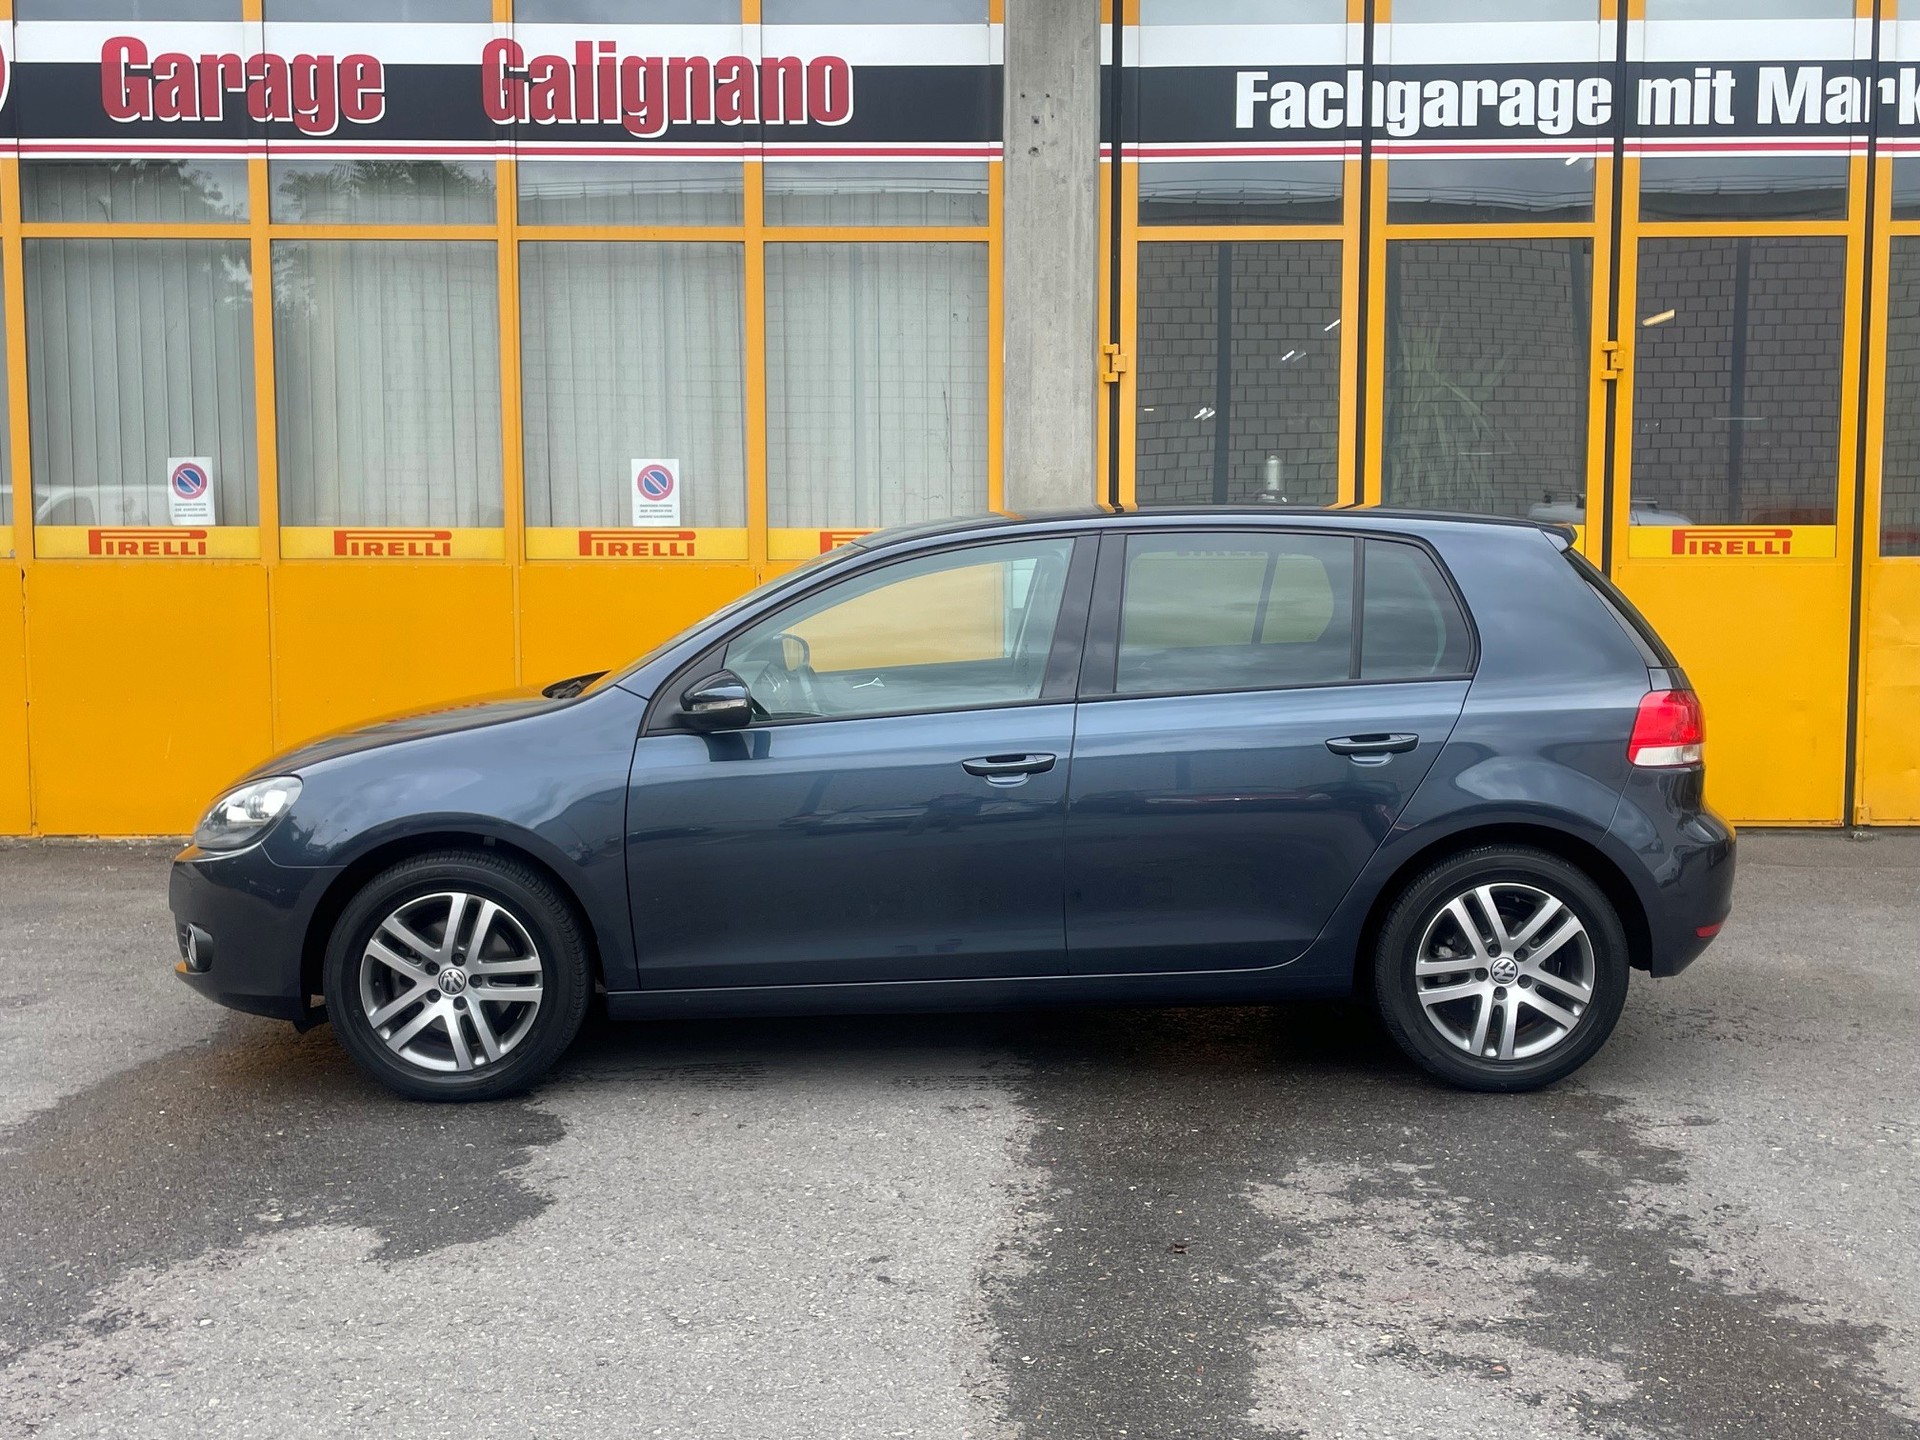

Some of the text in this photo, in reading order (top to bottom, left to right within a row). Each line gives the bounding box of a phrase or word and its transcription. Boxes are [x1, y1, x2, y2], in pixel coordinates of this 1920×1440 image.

[101, 36, 853, 138] Garage Galignano
[1235, 70, 1613, 136] Fachgarage
[1637, 68, 1735, 125] mit
[88, 530, 207, 555] PIRELLI
[334, 530, 452, 556] PIRELLI
[579, 531, 696, 556] PIRELLI
[1672, 529, 1793, 555] PIRELLI
